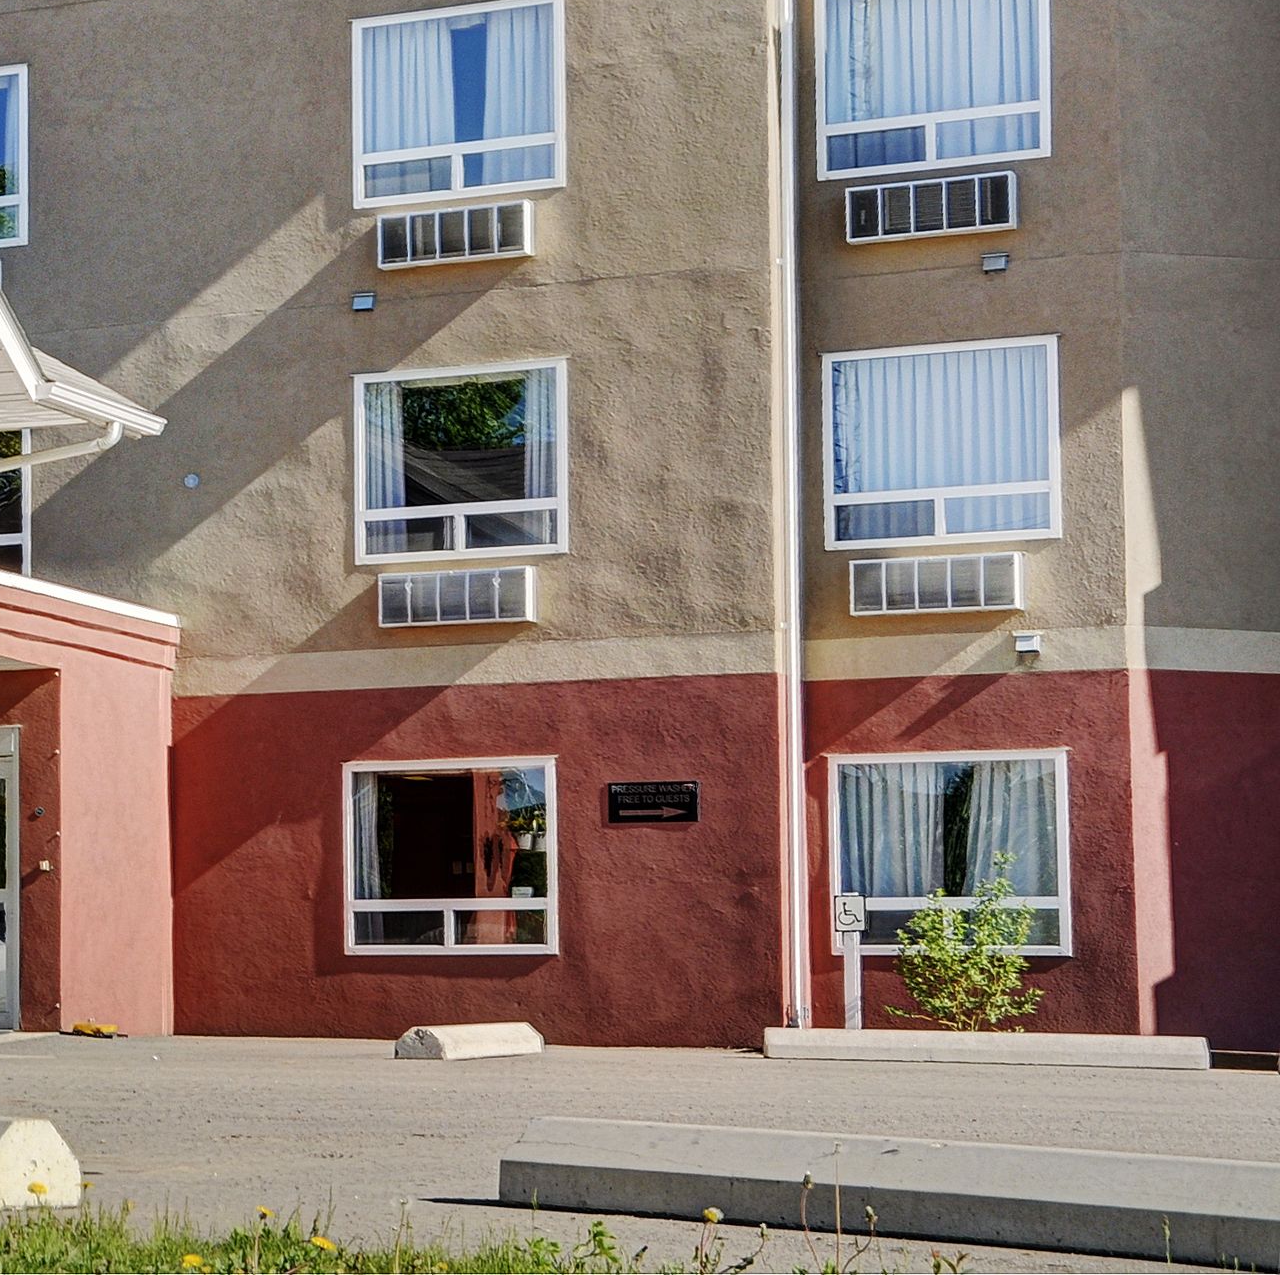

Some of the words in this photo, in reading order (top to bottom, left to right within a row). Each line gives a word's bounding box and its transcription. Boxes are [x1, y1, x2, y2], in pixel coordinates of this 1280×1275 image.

[611, 785, 657, 794] PRESSURE
[659, 783, 696, 793] WASHER
[618, 795, 641, 803] FREE
[642, 795, 654, 803] TO
[655, 794, 690, 803] GUESTS
